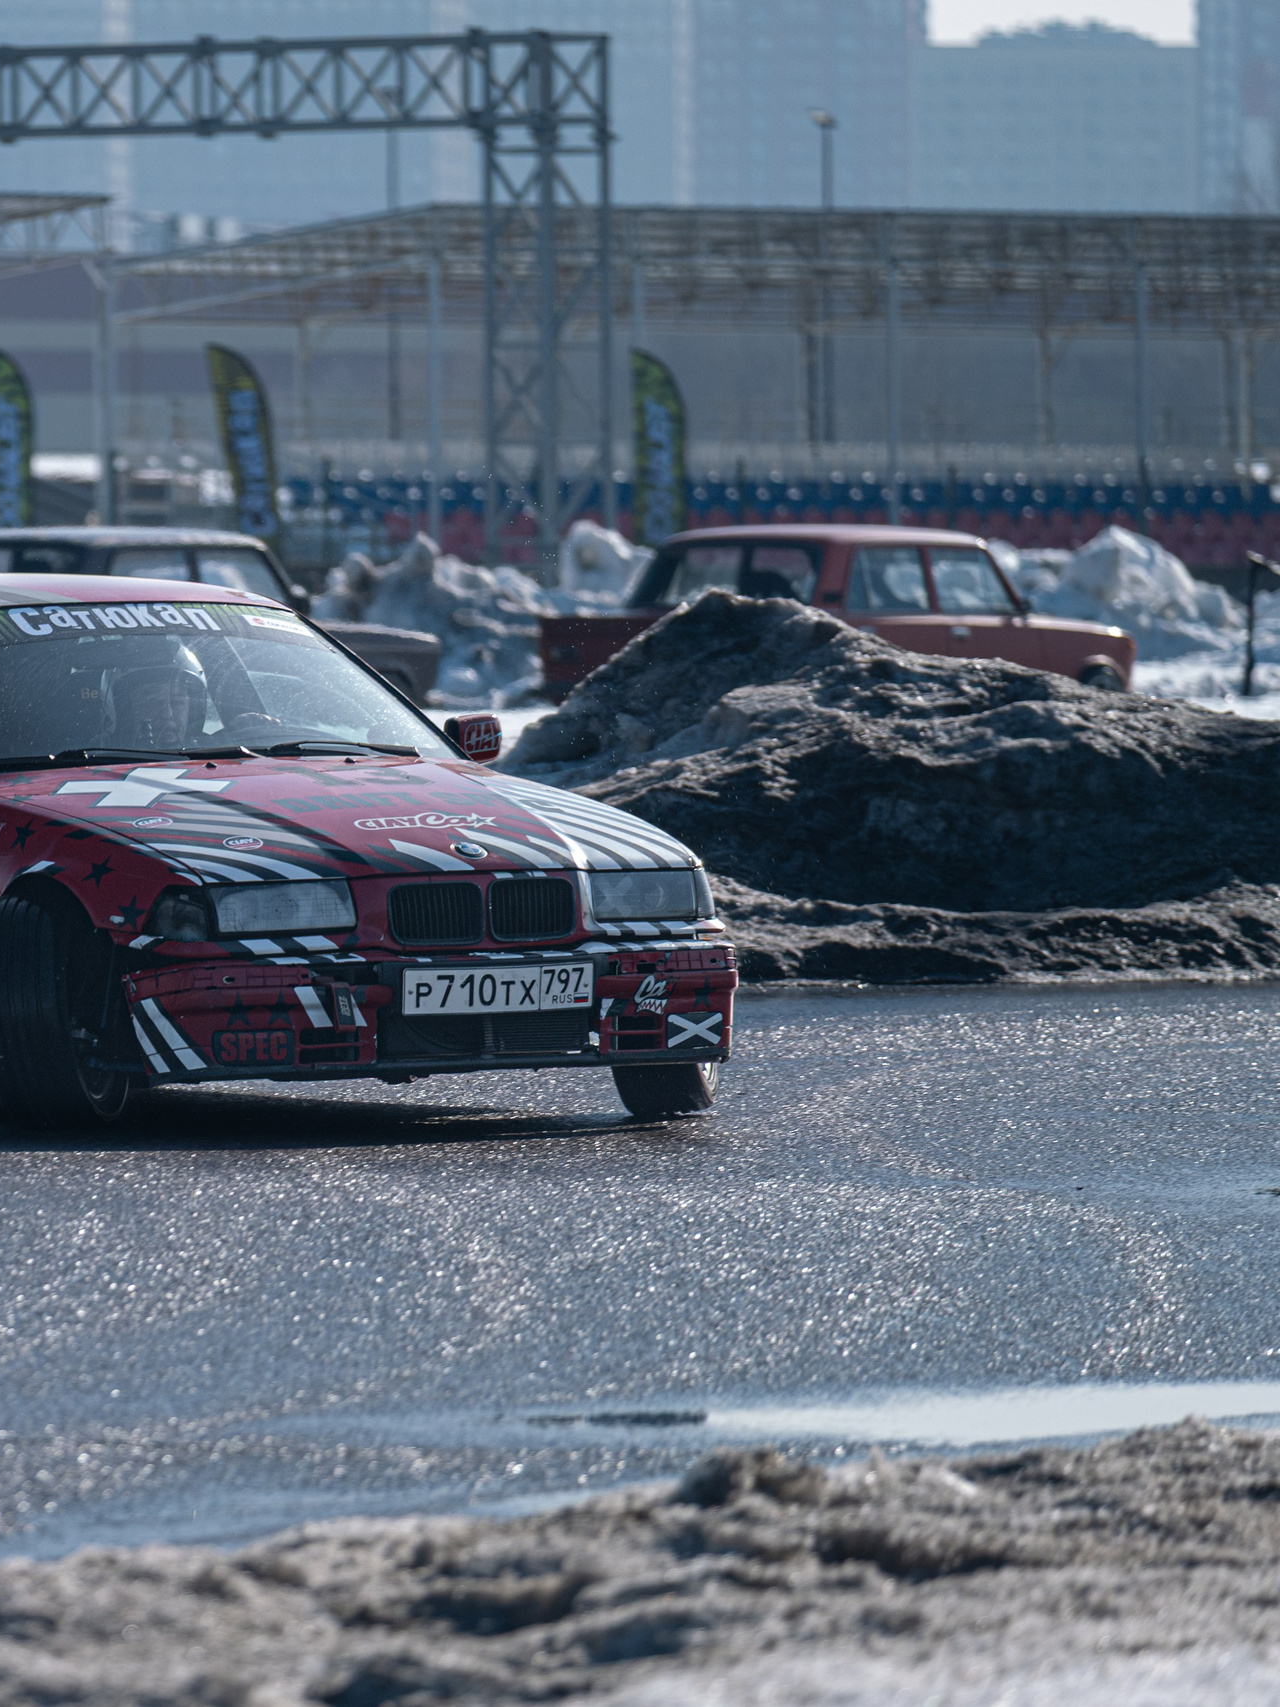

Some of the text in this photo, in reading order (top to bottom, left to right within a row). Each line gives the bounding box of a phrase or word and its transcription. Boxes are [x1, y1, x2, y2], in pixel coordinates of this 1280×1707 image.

[543, 967, 585, 995] 797
[552, 994, 573, 1004] RUS
[220, 1031, 288, 1063] SPEC
